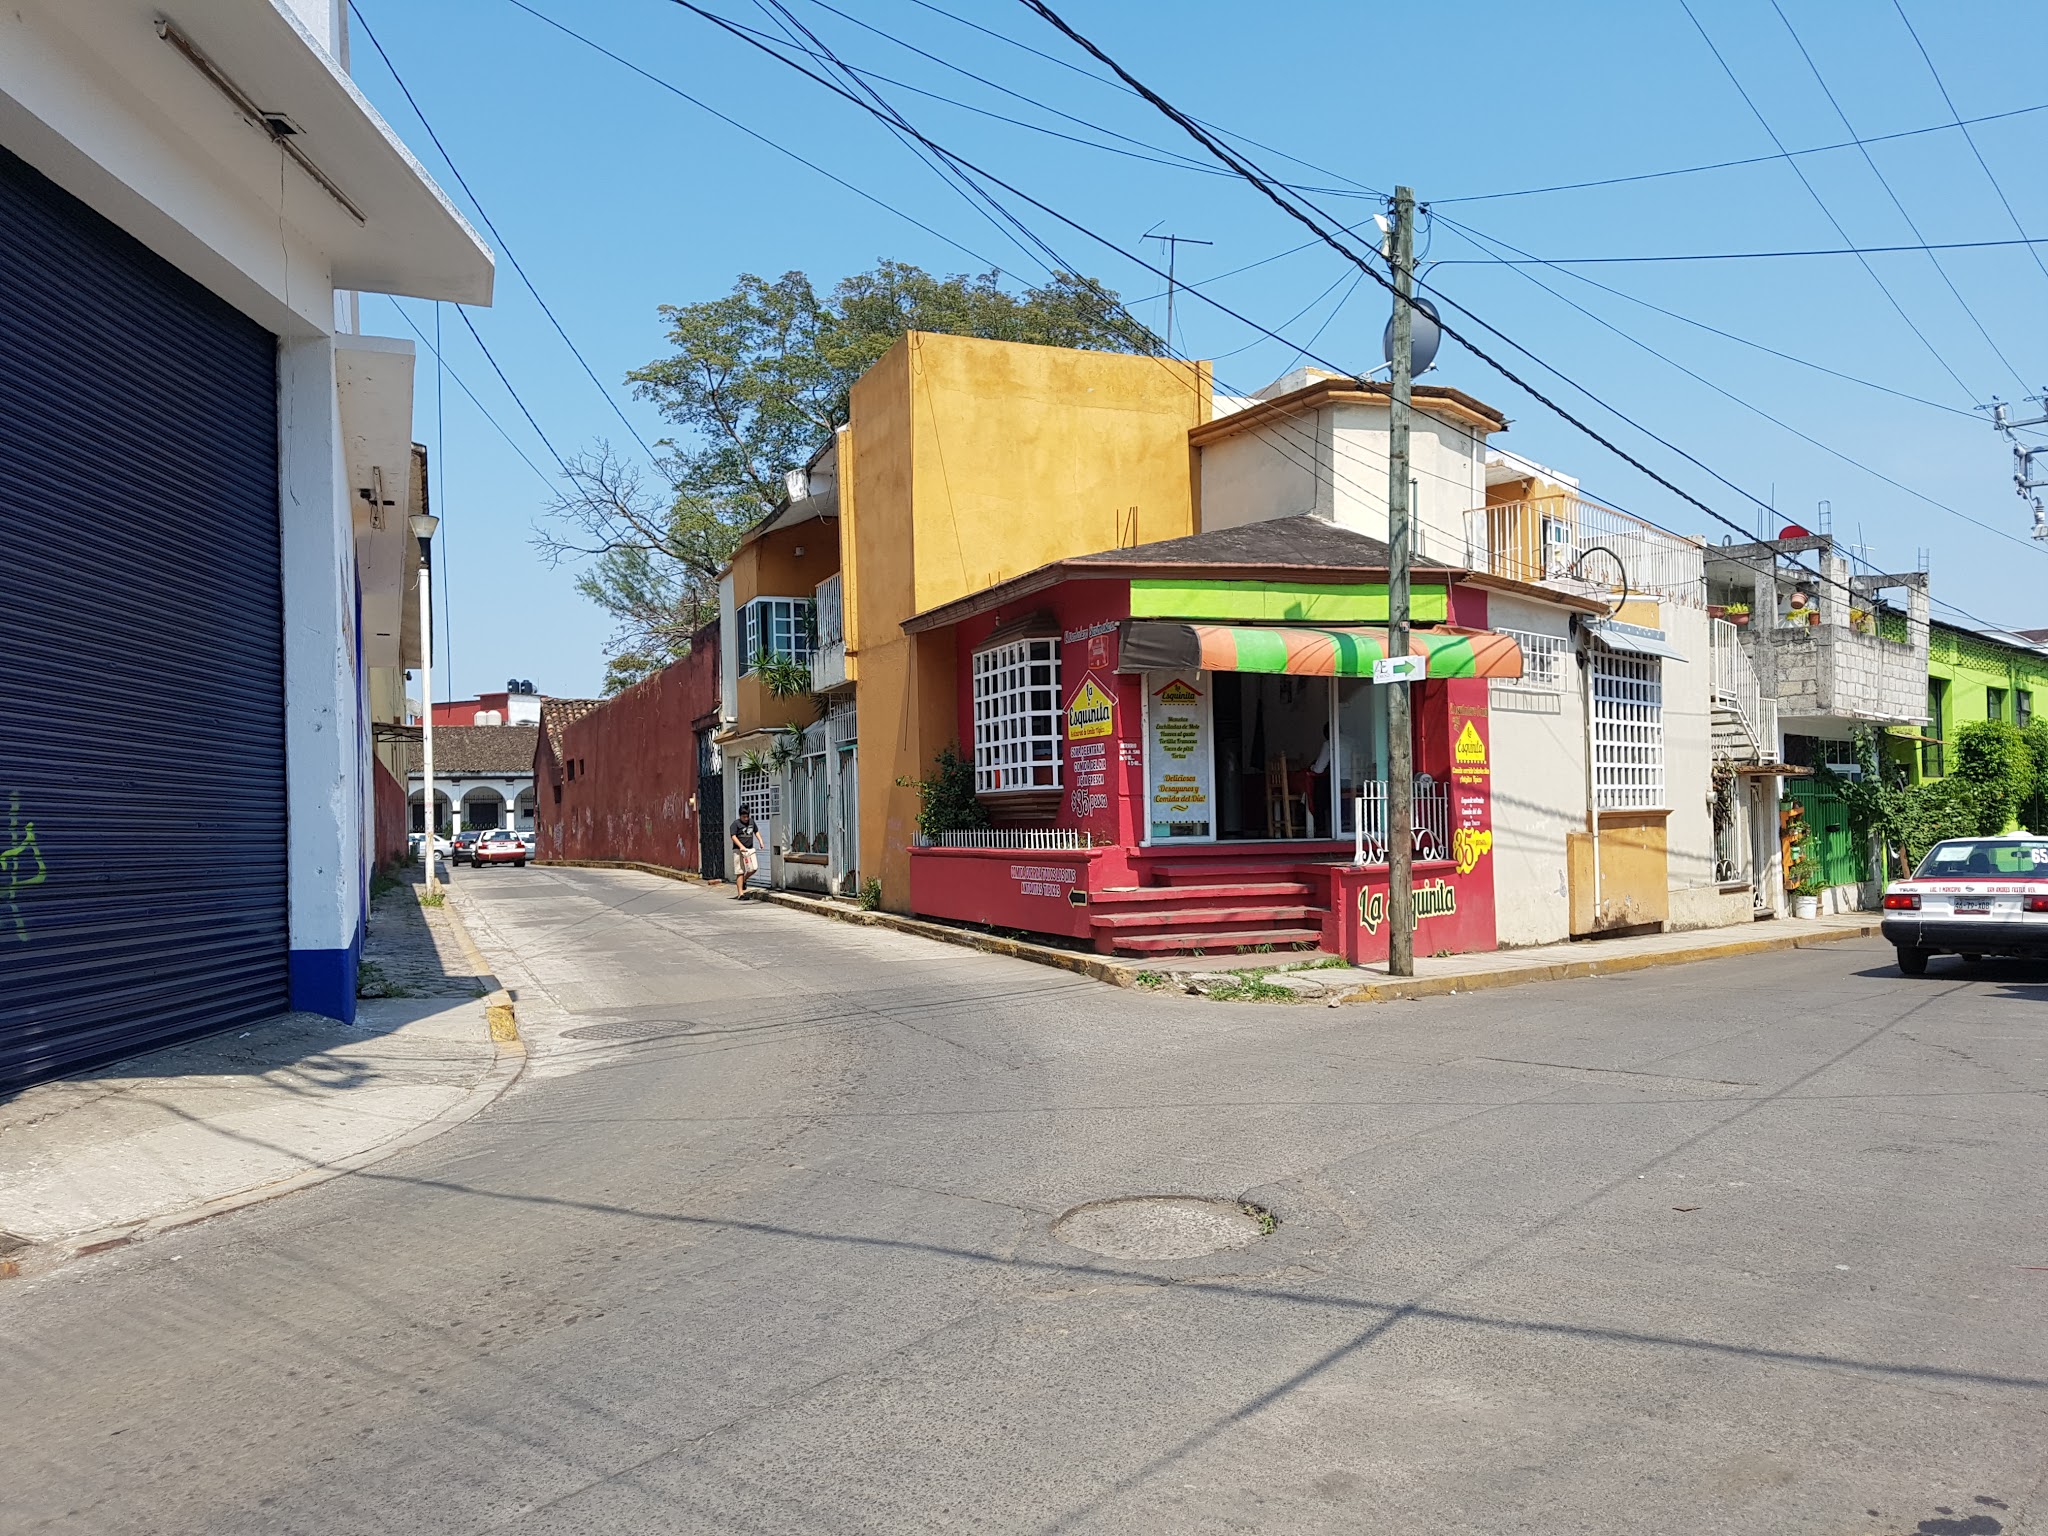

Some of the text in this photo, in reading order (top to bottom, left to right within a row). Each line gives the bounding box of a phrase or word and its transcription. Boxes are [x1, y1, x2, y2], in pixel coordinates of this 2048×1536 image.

[1161, 692, 1195, 702] Esquinita
[1069, 700, 1110, 729] Esquinita
[1457, 738, 1483, 756] Esquinita
[1164, 774, 1196, 782] Deliciosos
[1158, 785, 1194, 794] Desayunos
[1358, 885, 1383, 935] La
